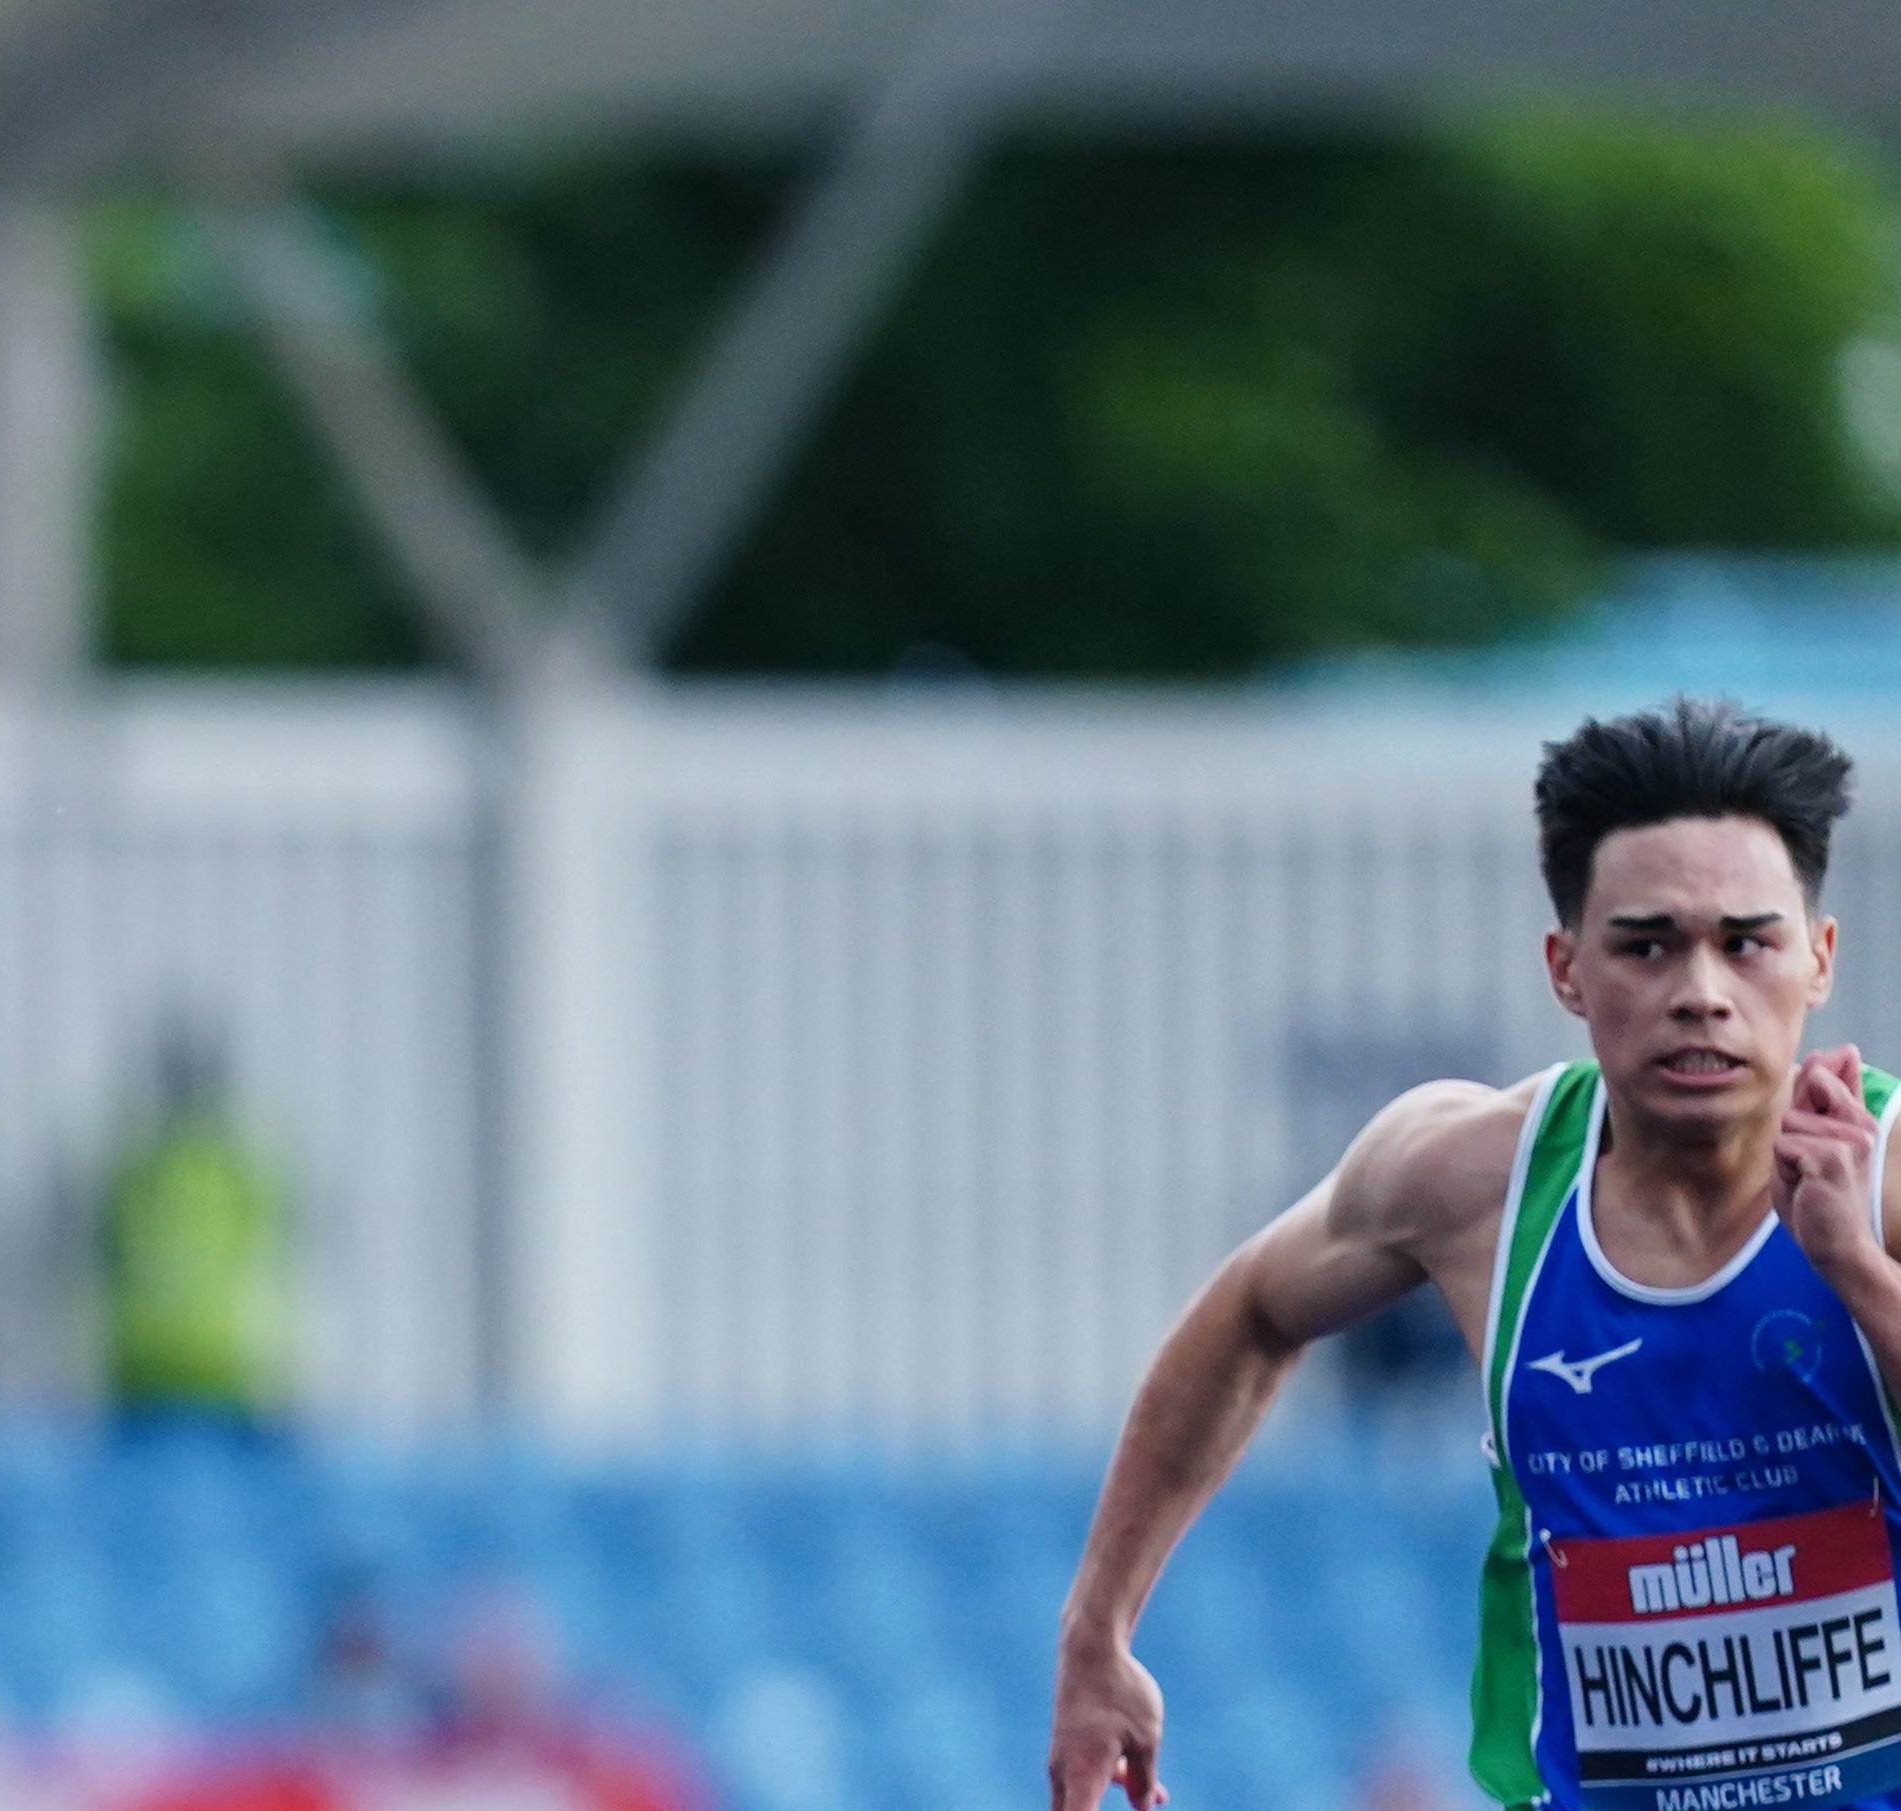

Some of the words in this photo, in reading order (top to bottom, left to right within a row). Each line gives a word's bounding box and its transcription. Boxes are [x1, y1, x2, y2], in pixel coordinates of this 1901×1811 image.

[1579, 1448, 1608, 1473] OF
[1617, 1439, 1746, 1470] SHEFFIELD
[1615, 1476, 1728, 1505] ATHLETIC
[1735, 1465, 1798, 1491] CLUB
[1628, 1534, 1796, 1614] müller
[1574, 1607, 1891, 1727] HINCHLIFFE
